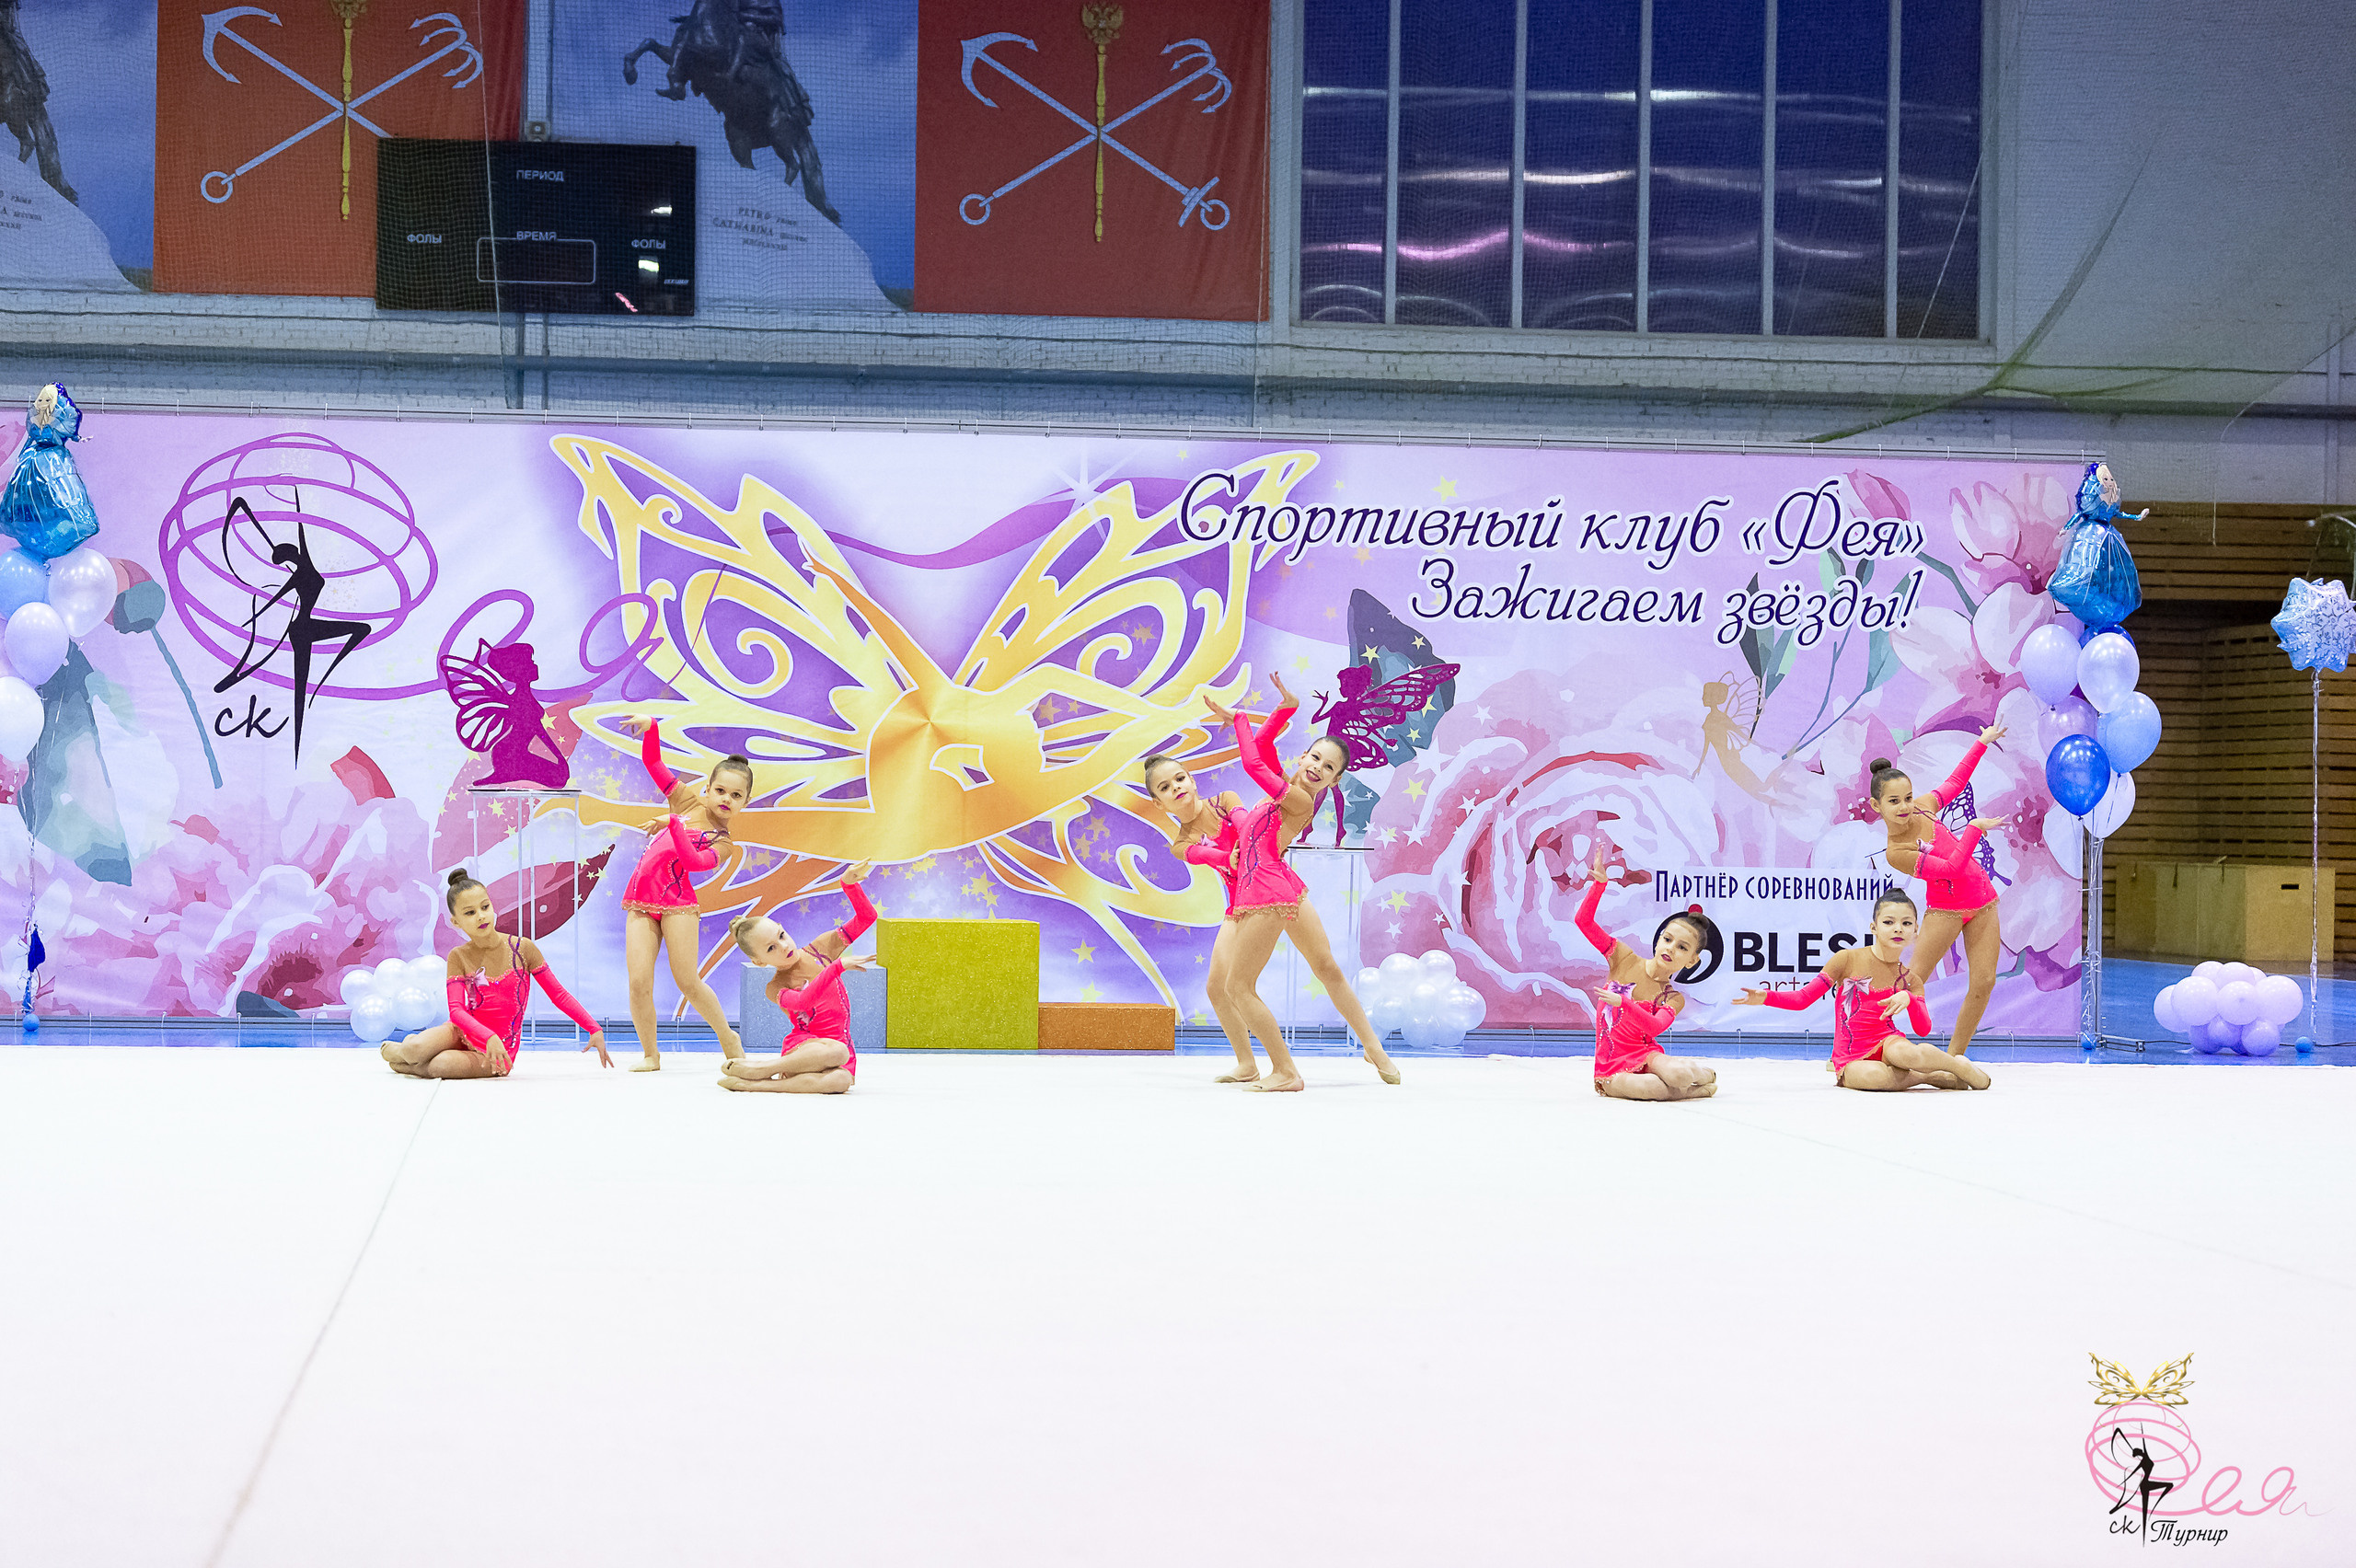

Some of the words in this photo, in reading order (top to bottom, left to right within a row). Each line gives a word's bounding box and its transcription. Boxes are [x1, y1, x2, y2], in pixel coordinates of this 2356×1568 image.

[516, 169, 564, 182] ПЕРИОД
[407, 233, 442, 245] ФОЛЫ
[516, 231, 558, 241] ВРЕМЯ
[631, 238, 666, 249] ФОЛЫ
[1181, 473, 1563, 562] Спортивный
[1579, 499, 1730, 570] клуб
[1742, 479, 1924, 565] «Фея»
[1412, 558, 1703, 623] Зажигаем
[1717, 570, 1923, 646] звёзды!
[1734, 931, 1875, 973] BLES
